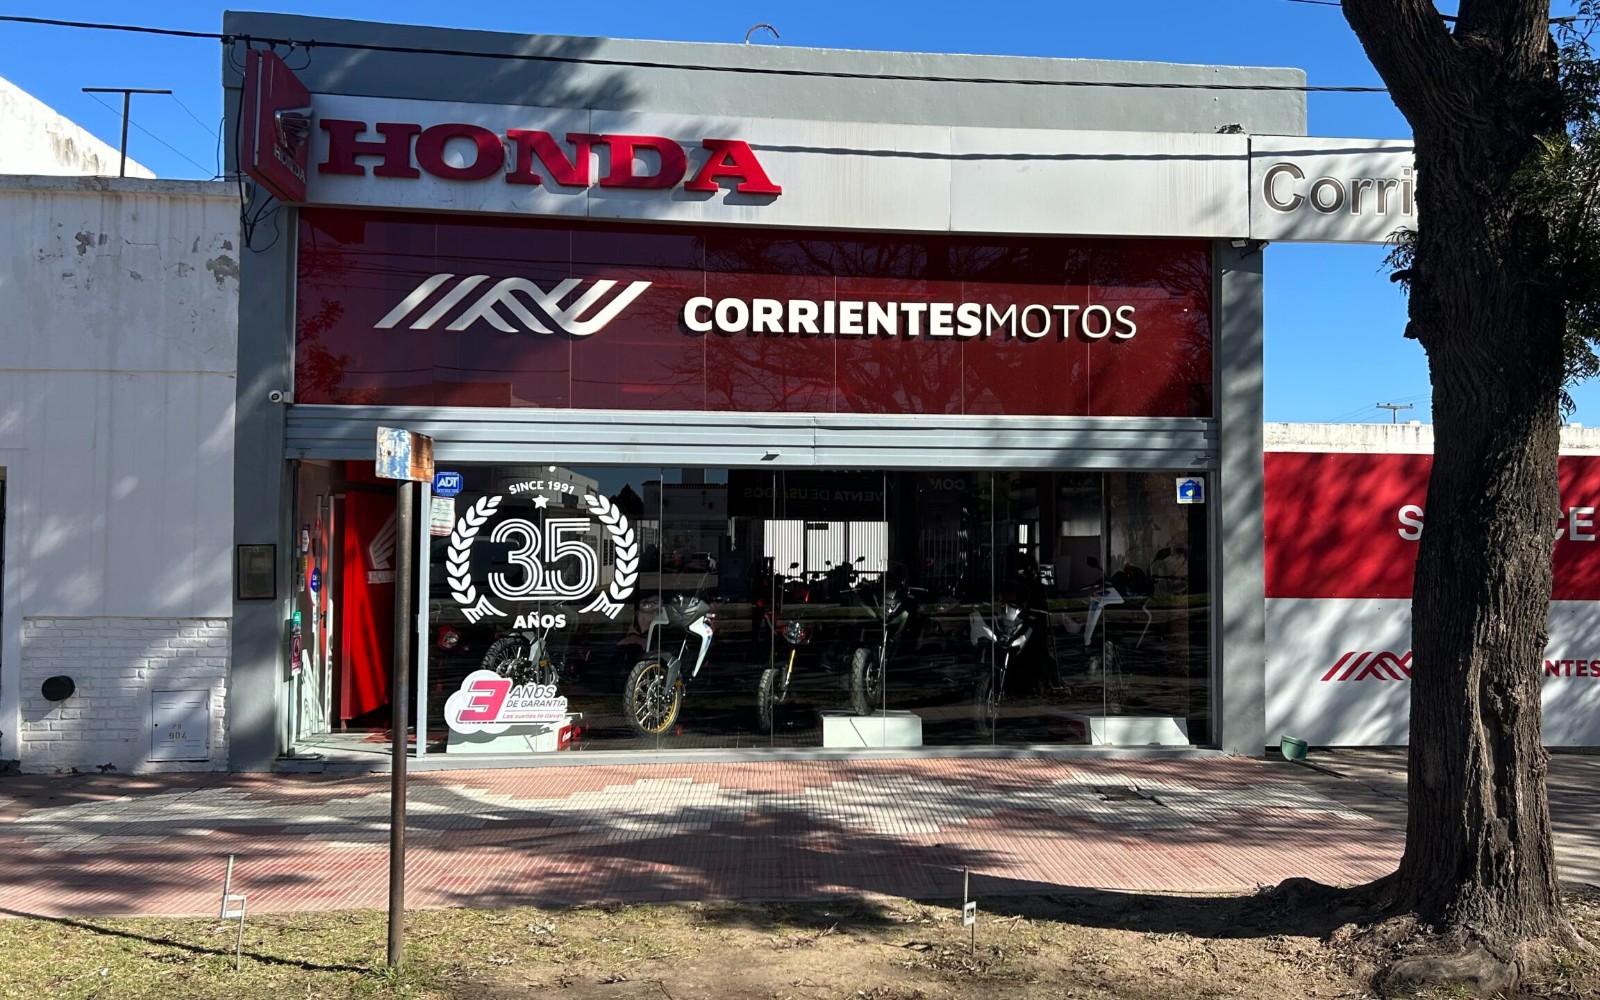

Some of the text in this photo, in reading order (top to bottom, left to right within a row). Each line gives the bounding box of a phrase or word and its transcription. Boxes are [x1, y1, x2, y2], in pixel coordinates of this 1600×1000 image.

[318, 118, 782, 195] HONDA
[437, 476, 459, 488] ADT
[508, 480, 575, 495] SINCE 1991
[487, 517, 598, 602] 35
[512, 611, 567, 629] AÑOS
[459, 680, 555, 721] 3 AÑOS
[506, 699, 519, 708] DE
